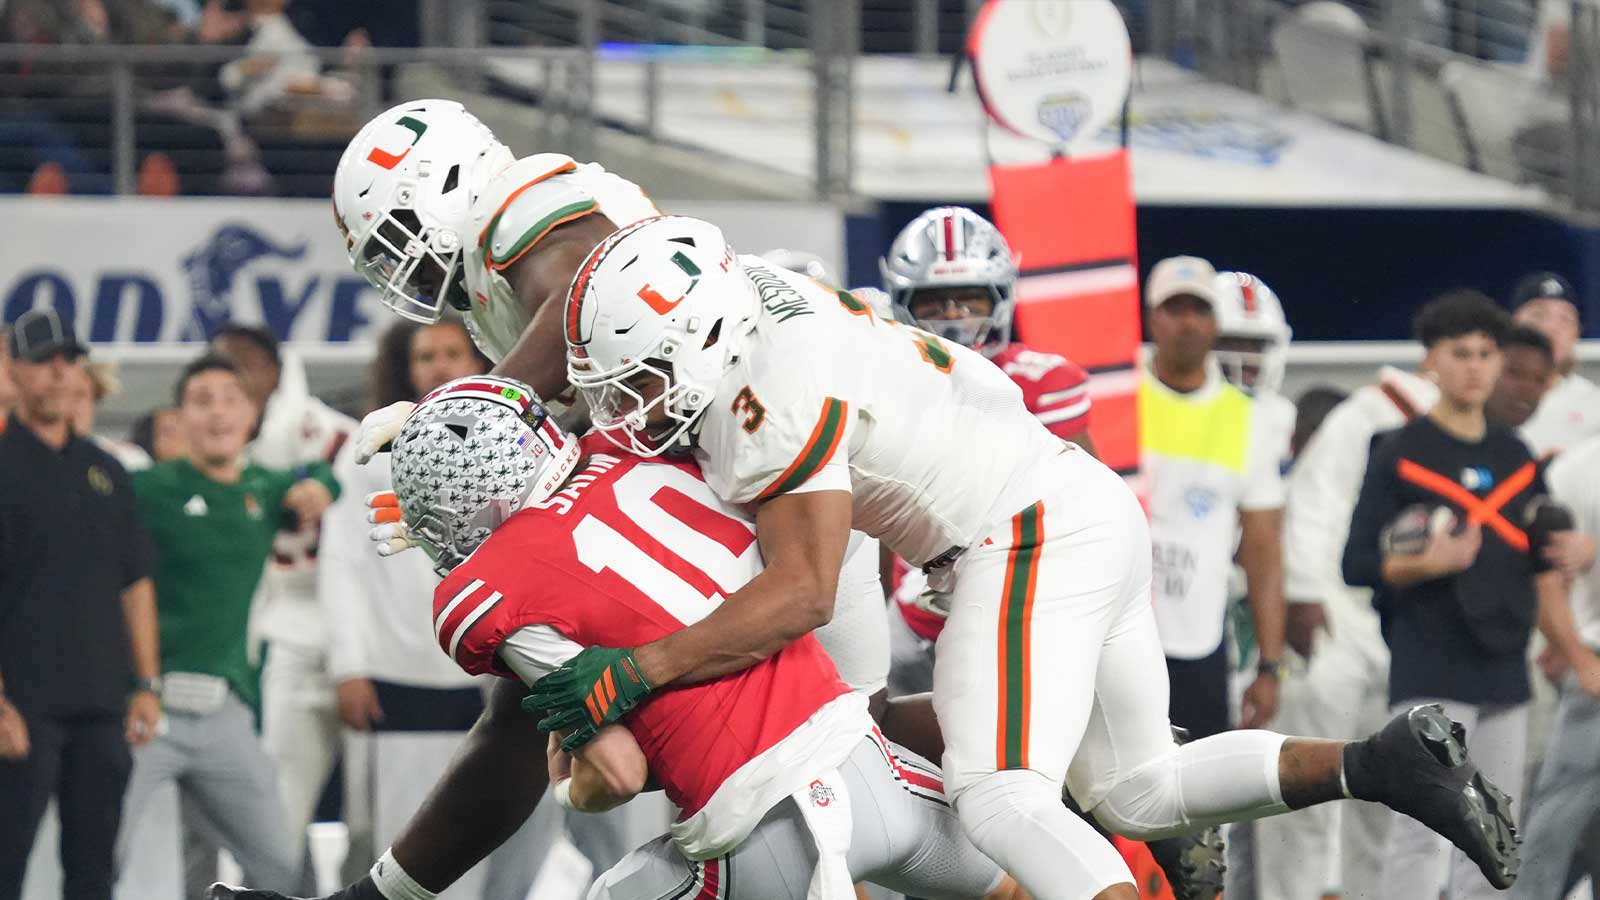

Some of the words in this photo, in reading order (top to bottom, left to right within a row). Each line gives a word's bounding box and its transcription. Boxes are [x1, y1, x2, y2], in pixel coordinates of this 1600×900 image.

[731, 385, 767, 435] 3
[531, 443, 544, 459] 10
[572, 462, 766, 627] 10
